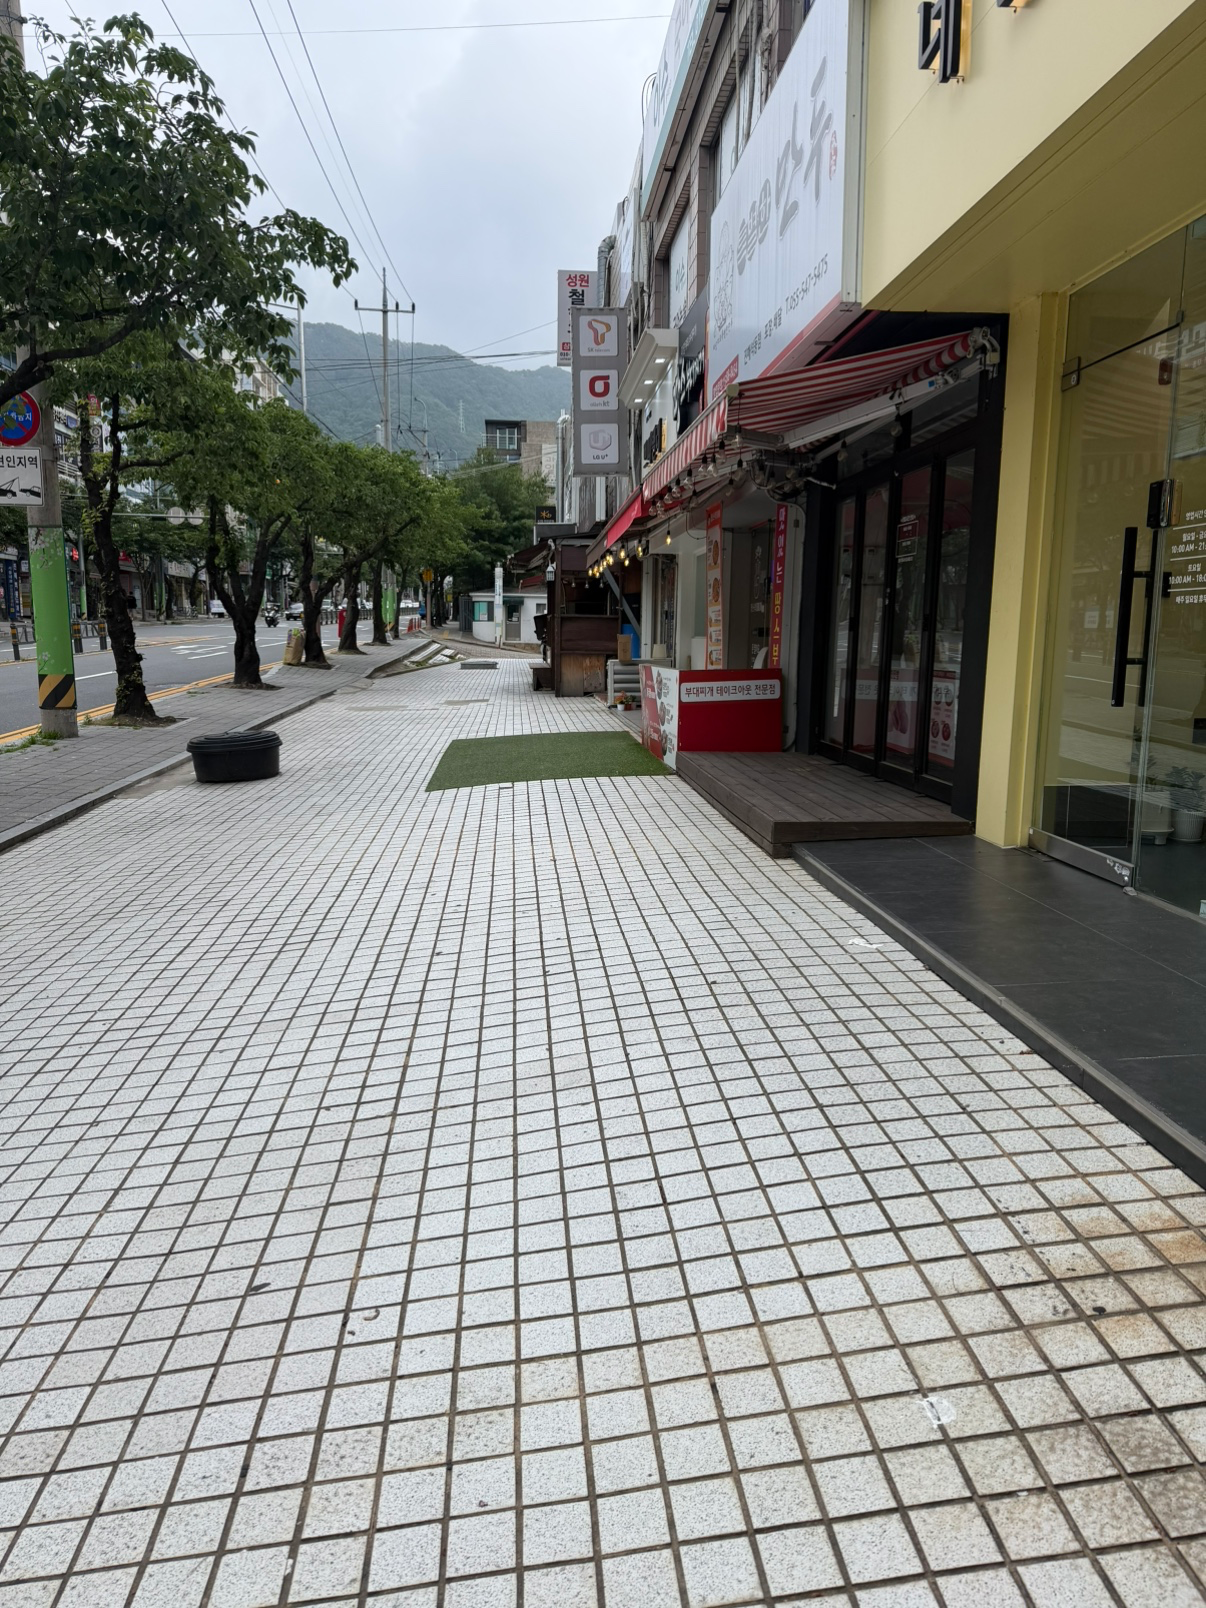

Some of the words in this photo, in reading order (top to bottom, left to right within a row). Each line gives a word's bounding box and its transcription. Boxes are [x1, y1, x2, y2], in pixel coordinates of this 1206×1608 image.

[775, 56, 832, 240] 만두
[566, 273, 590, 288] 성원
[1185, 543, 1195, 553] AM
[1187, 562, 1201, 572] 토요일
[1182, 574, 1192, 584] AM
[685, 685, 714, 698] 부대찌개
[716, 684, 752, 697] 테이크아웃
[754, 683, 776, 696] 전문점
